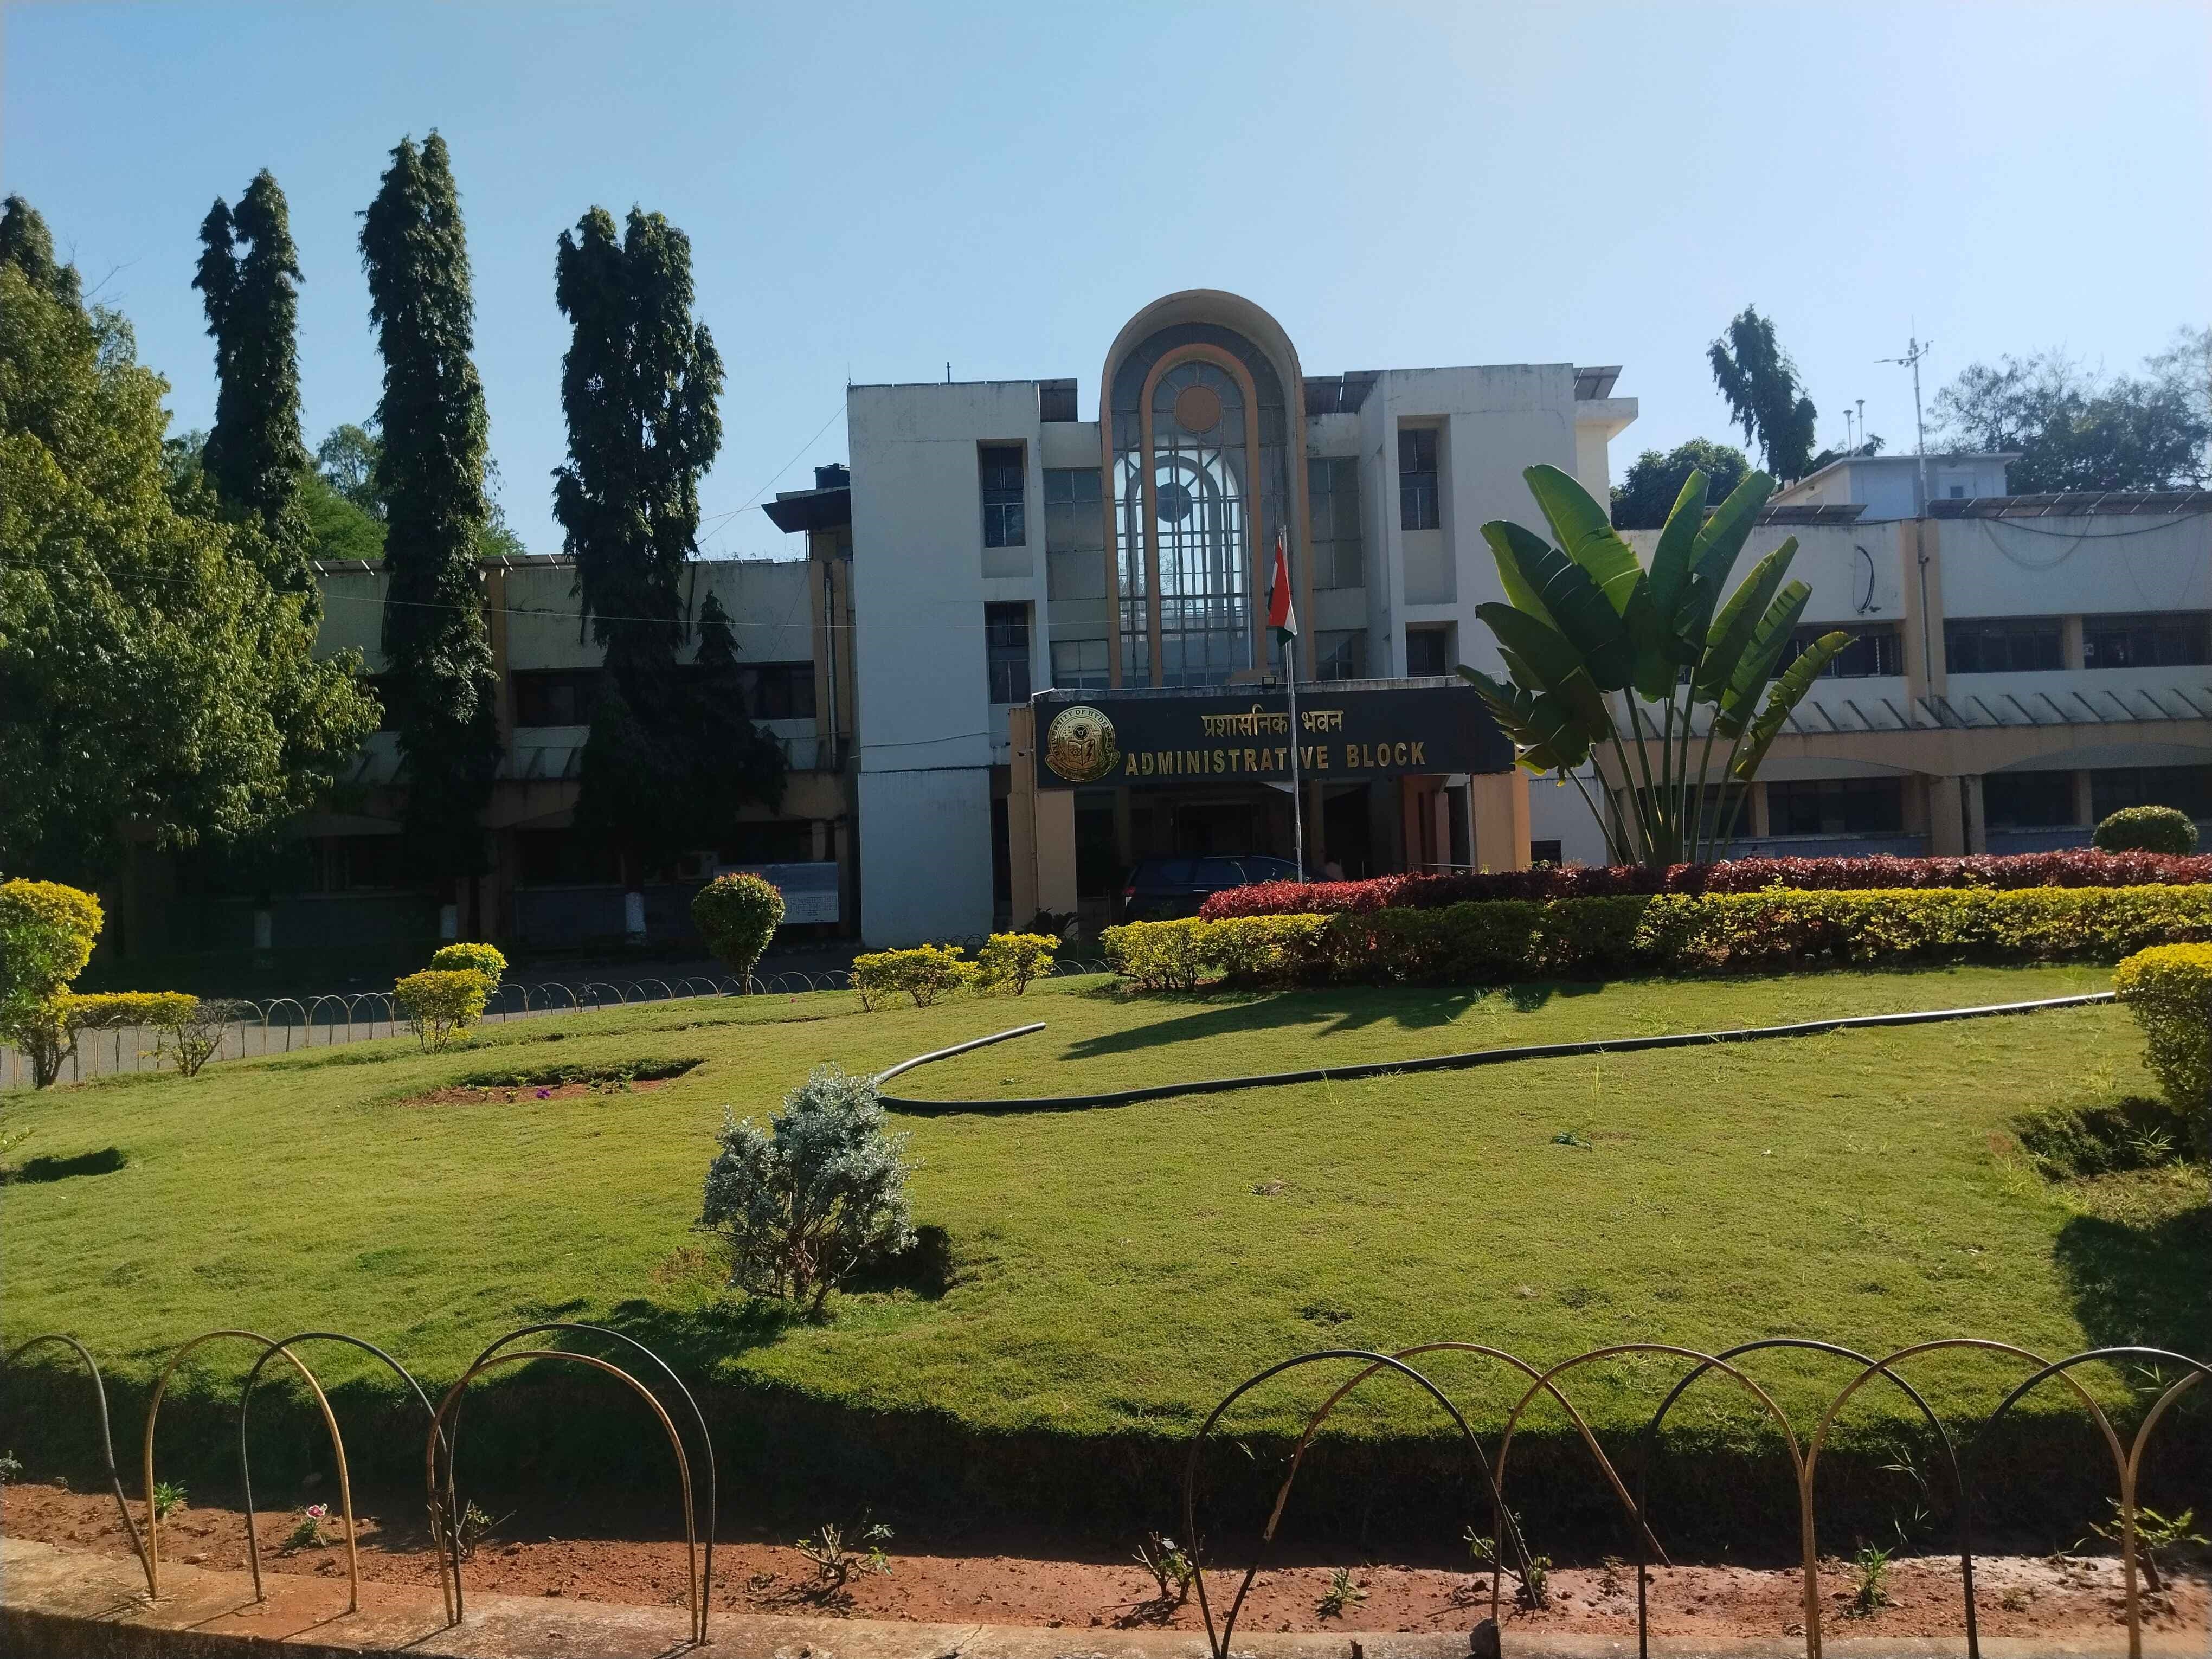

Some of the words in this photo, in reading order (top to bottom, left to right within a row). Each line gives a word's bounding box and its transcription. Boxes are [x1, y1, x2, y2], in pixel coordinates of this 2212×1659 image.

[1051, 711, 1073, 756] UNIVERSITY
[1201, 704, 1289, 737] प्रशासनिक
[1301, 710, 1344, 733] भवन
[1125, 746, 1328, 776] ADMINISTRATVE
[1346, 742, 1425, 768] BLOCK
